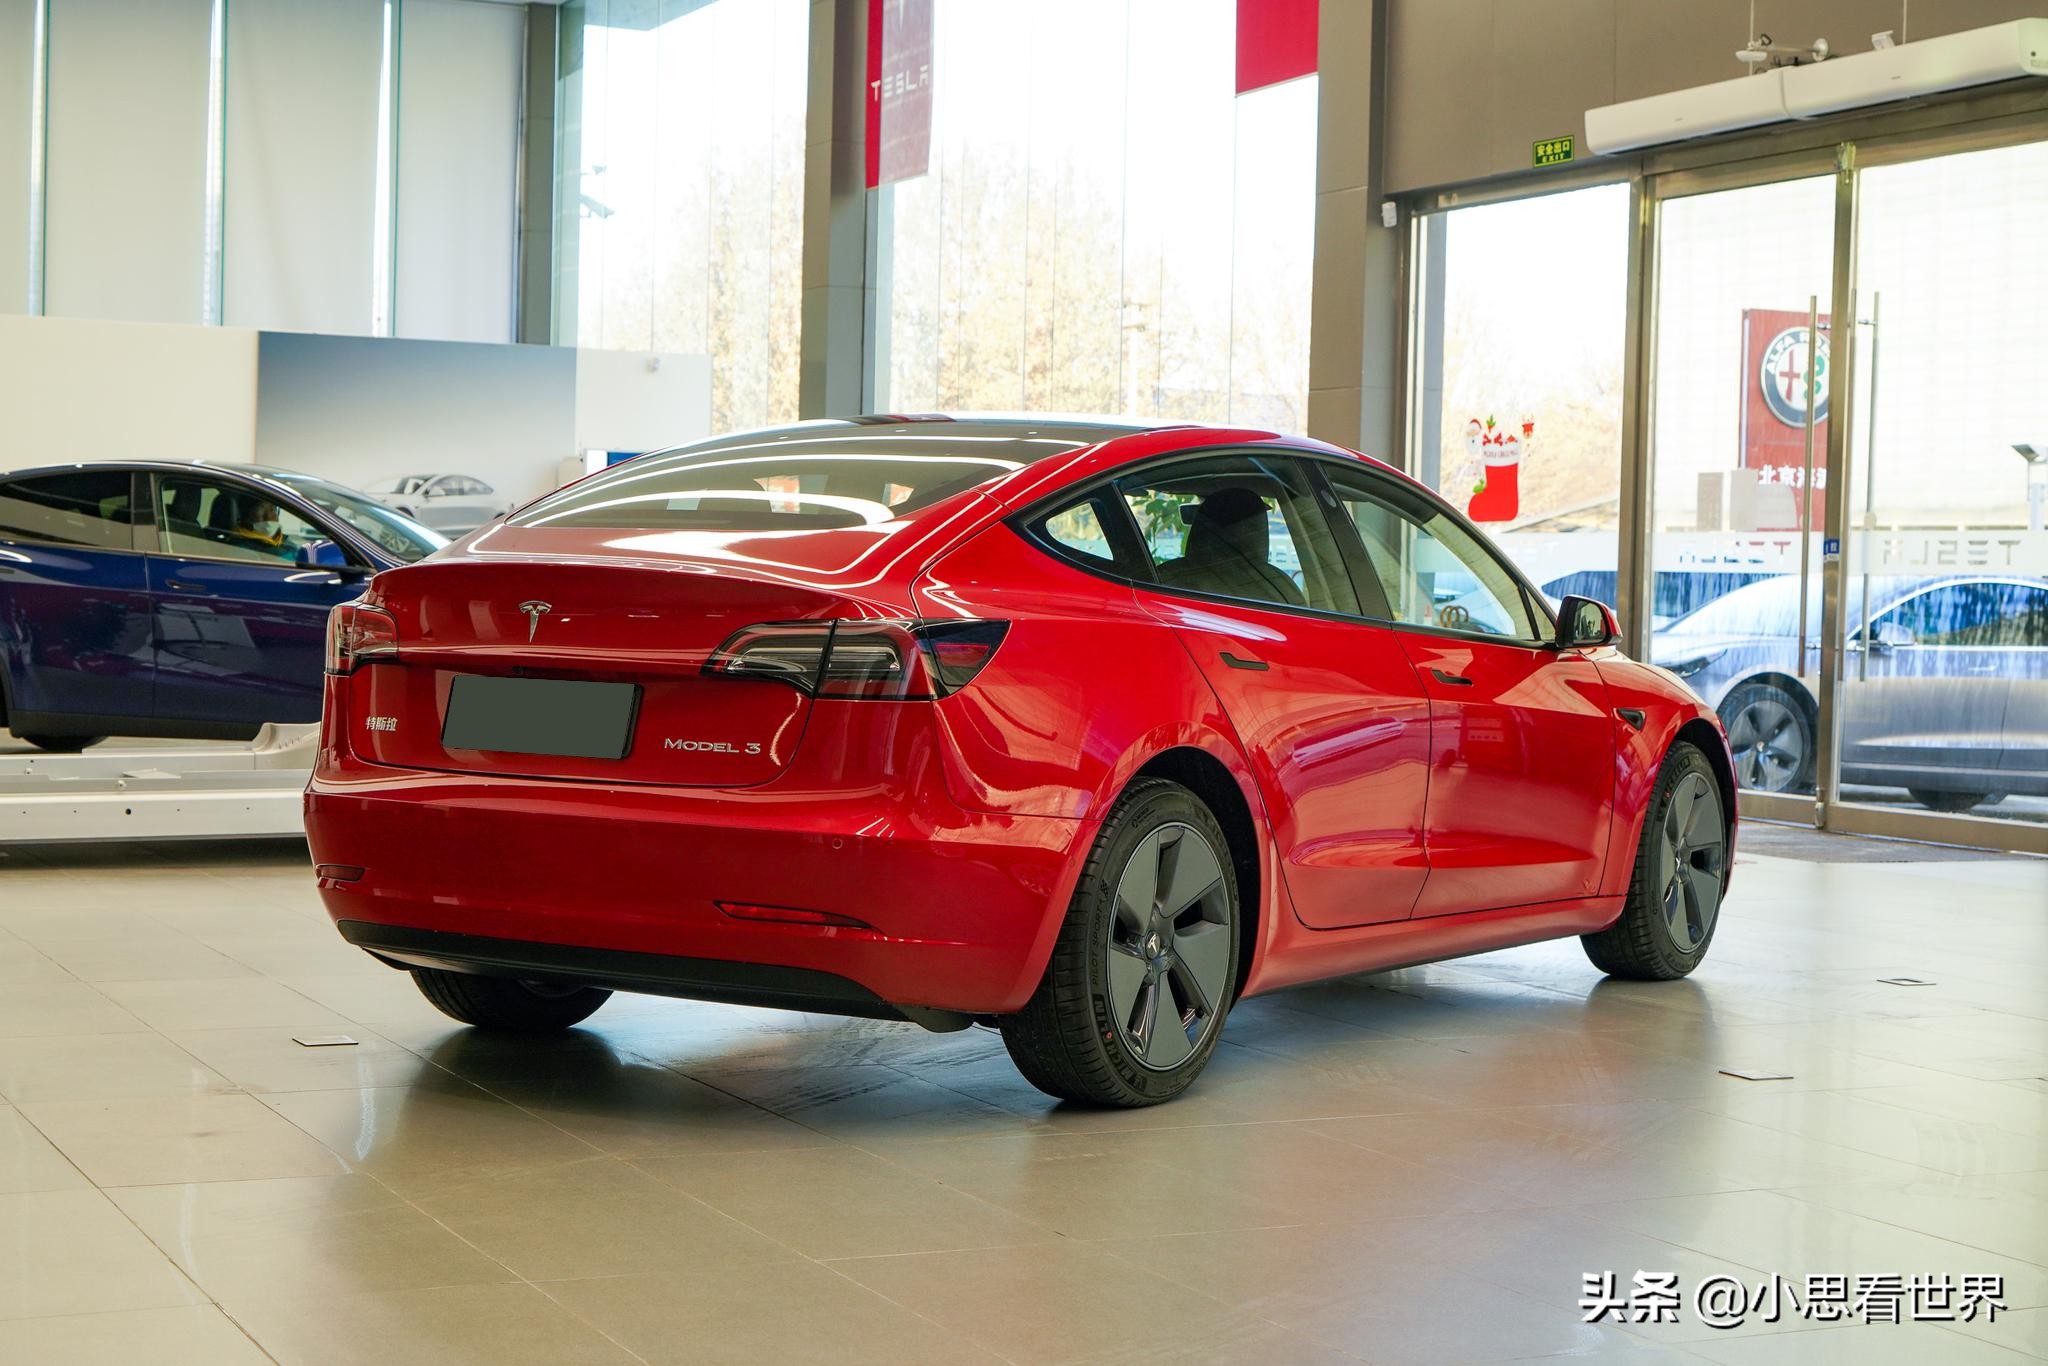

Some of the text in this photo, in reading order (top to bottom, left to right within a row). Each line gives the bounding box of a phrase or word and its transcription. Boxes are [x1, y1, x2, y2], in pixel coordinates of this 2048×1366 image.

[871, 65, 928, 102] TESLA
[1537, 141, 1570, 156] 安全出口
[1542, 153, 1565, 163] EXIT
[365, 716, 398, 731] 特斯拉
[664, 738, 761, 754] MODEL 3
